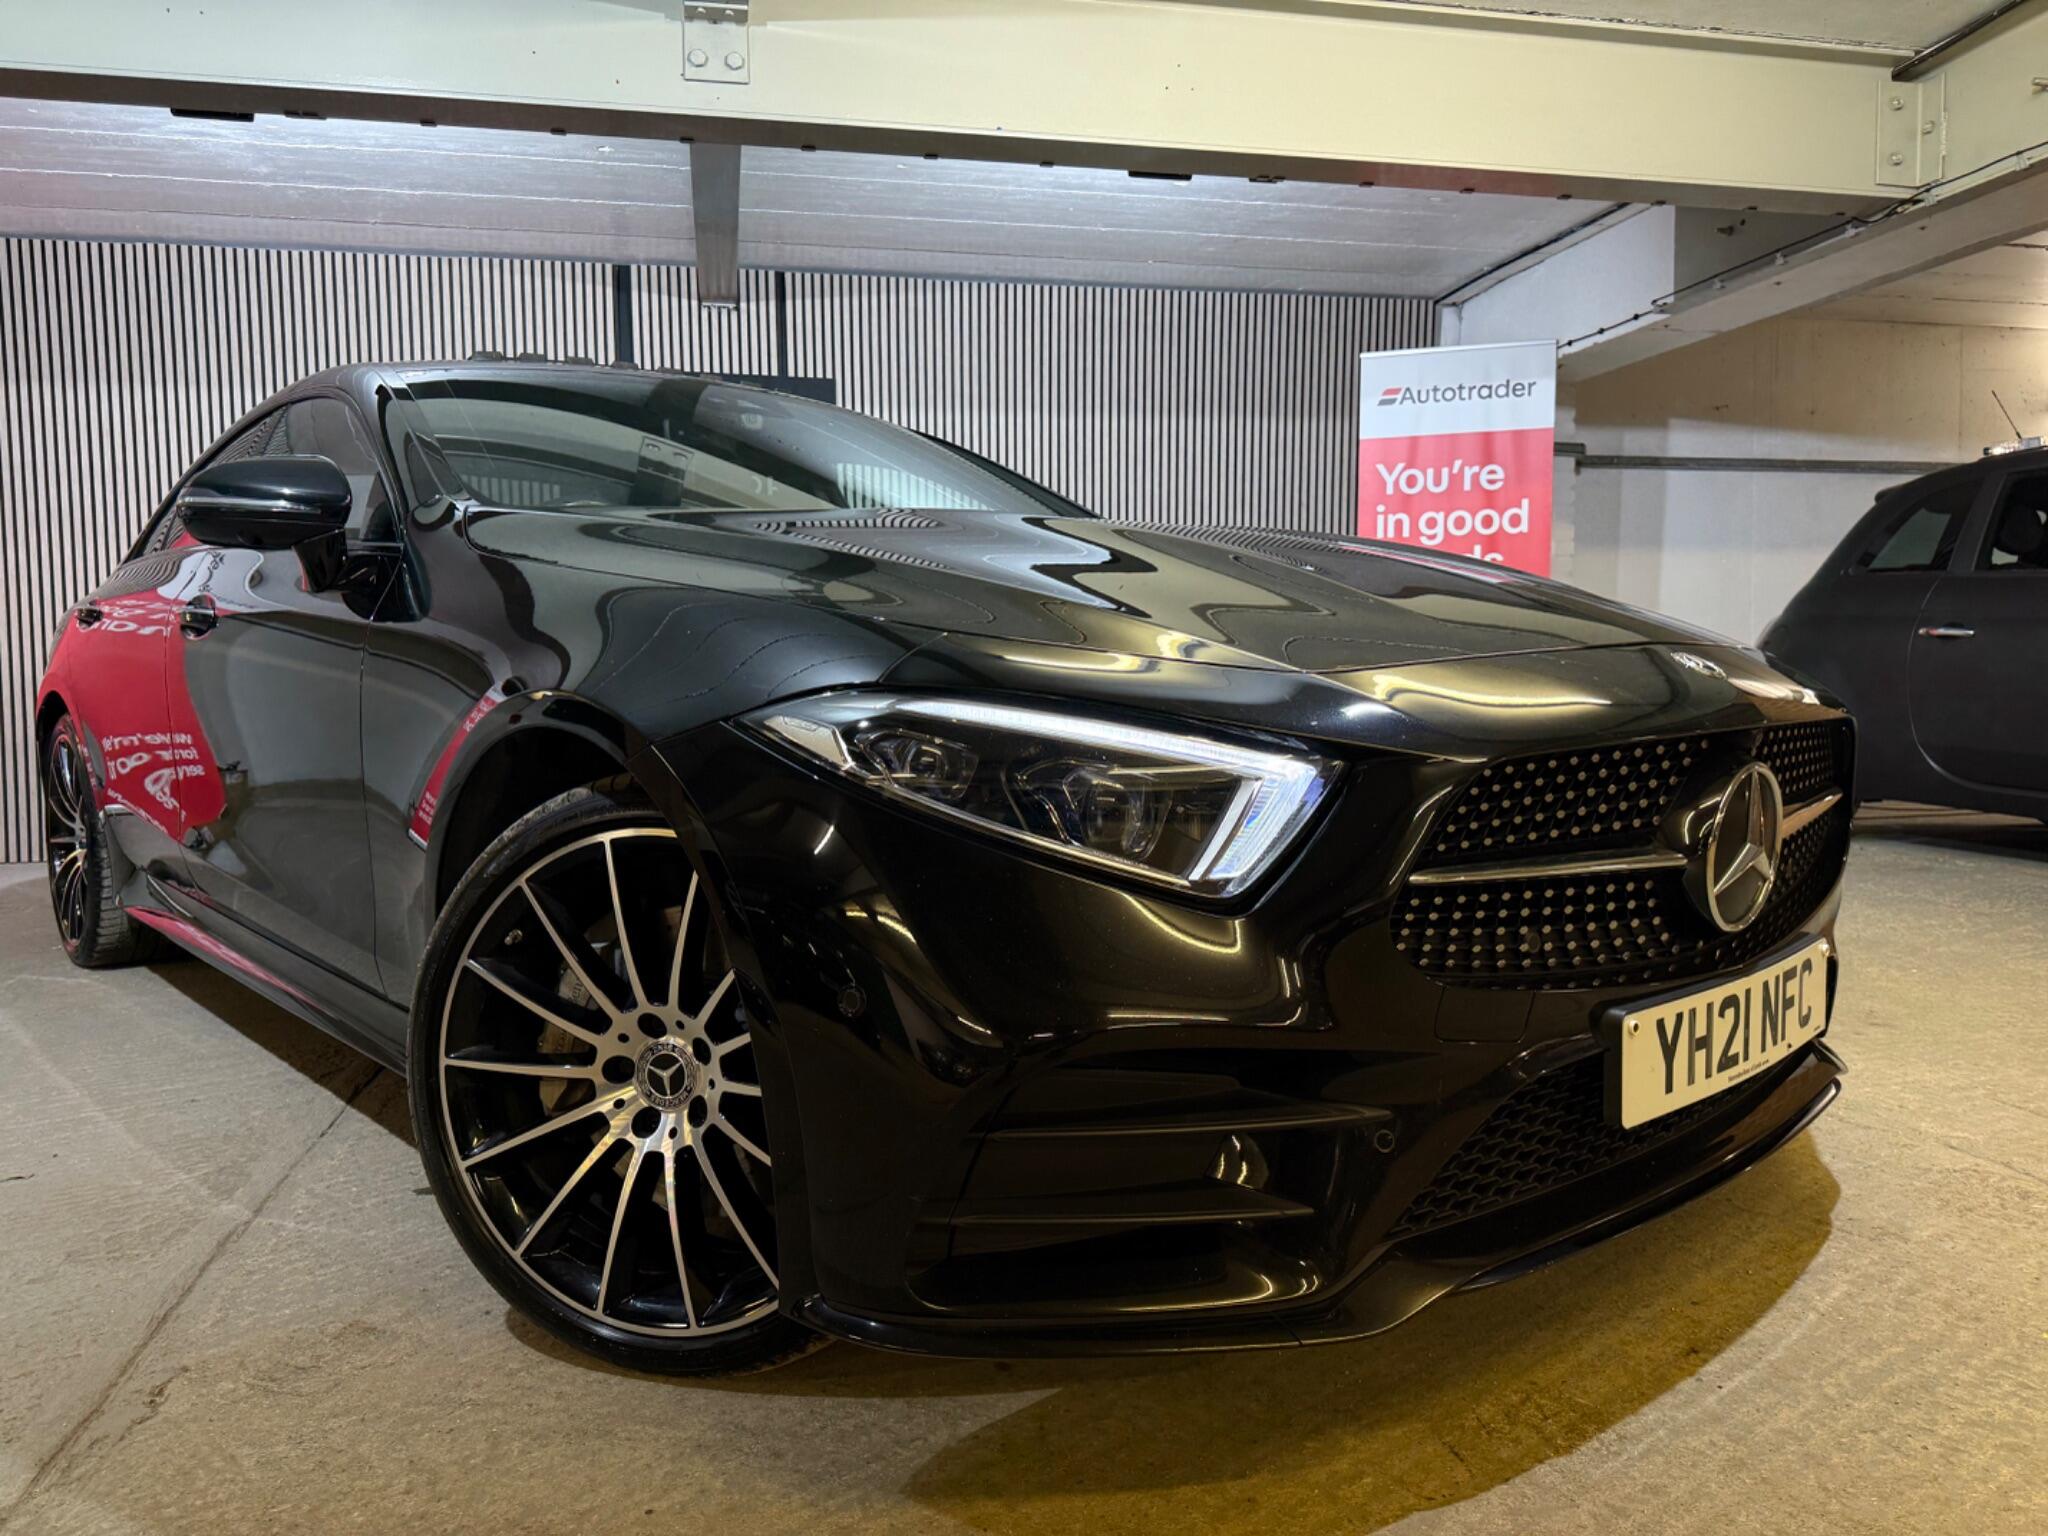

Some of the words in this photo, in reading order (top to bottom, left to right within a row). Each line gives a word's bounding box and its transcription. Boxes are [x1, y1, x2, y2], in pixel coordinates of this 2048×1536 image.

[1399, 379, 1537, 405] Autotrader
[1376, 459, 1505, 495] You're
[1376, 504, 1411, 539] in
[1418, 498, 1530, 546] good
[1656, 987, 1751, 1095] YH21
[1761, 957, 1813, 1054] NFC
